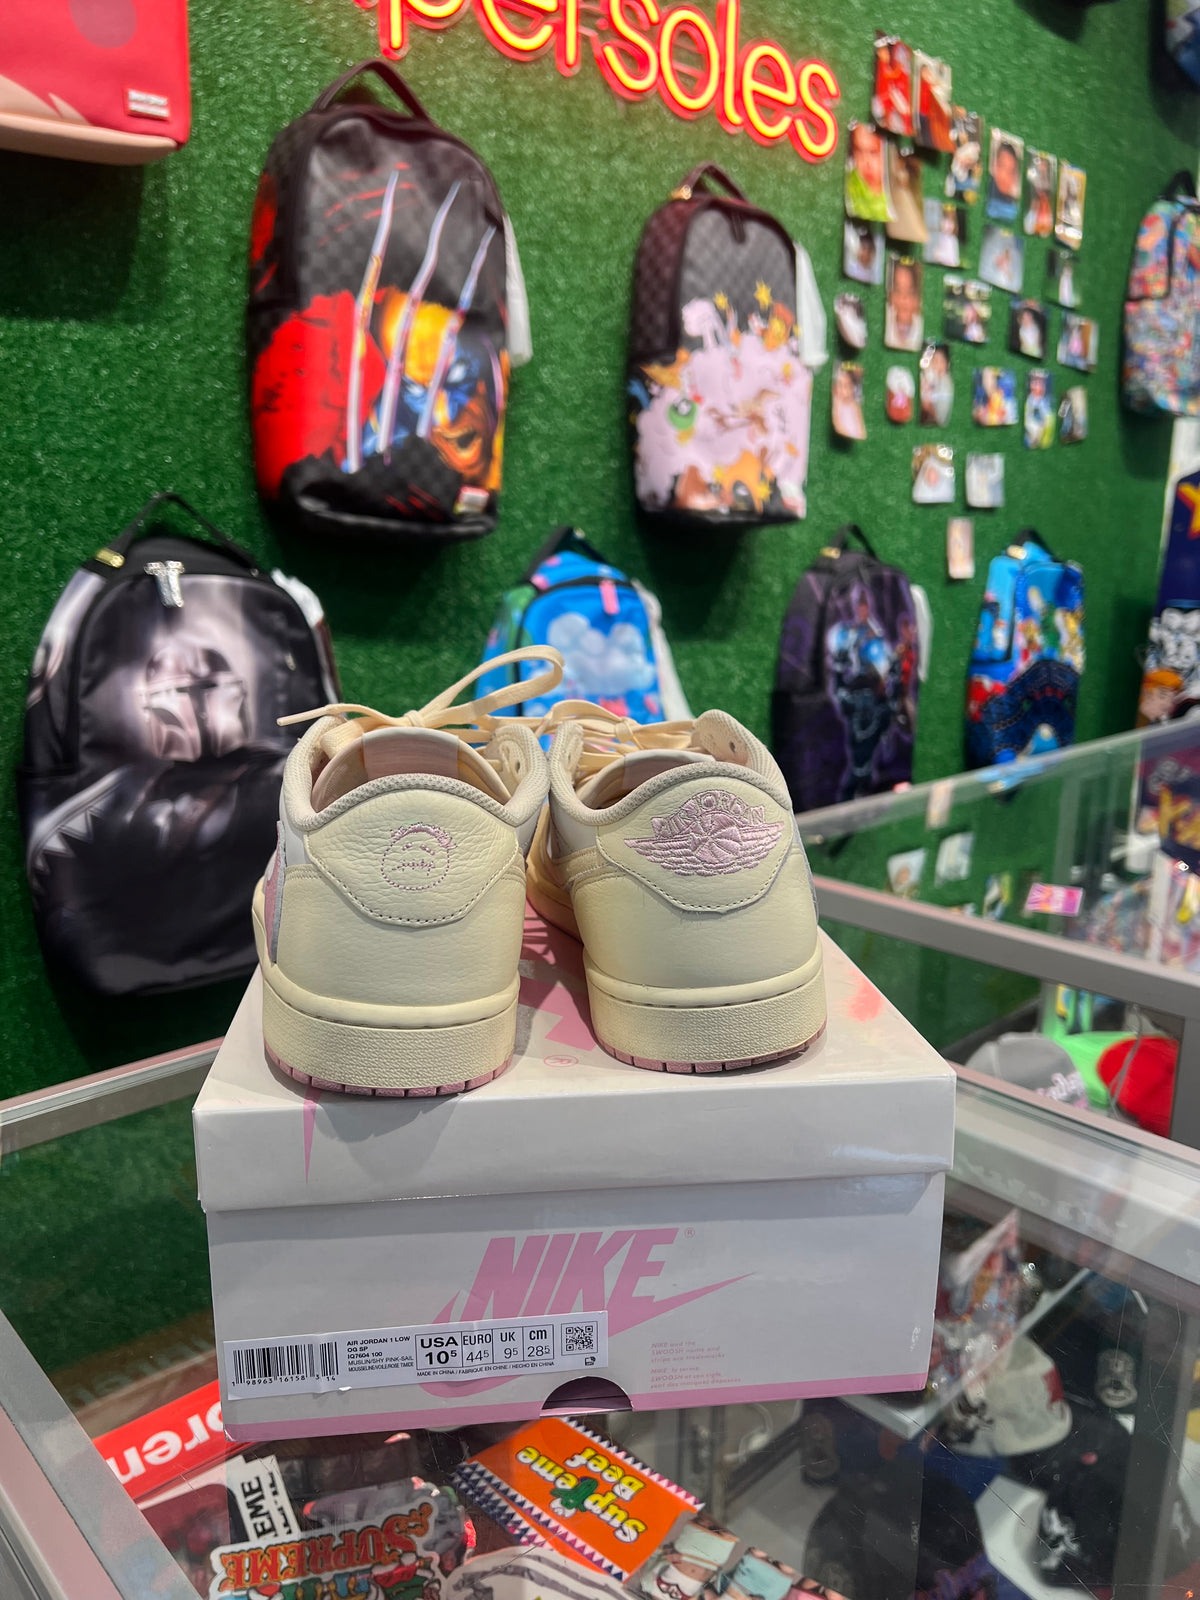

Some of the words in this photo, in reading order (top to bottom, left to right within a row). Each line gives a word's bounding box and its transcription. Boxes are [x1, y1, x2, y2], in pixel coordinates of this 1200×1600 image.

[354, 0, 840, 162] persoles
[465, 1228, 680, 1318] NIKE
[463, 1333, 492, 1346] EURO
[500, 1331, 516, 1342] UK
[529, 1328, 548, 1341] cm
[420, 1336, 459, 1349] USA
[348, 1352, 370, 1360] IQ7604
[652, 1348, 684, 1356] SWOOSH
[348, 1358, 385, 1366] MUSLIN/SHY
[279, 1375, 306, 1383] 16158
[564, 1447, 646, 1502] Beef
[516, 1446, 648, 1544] Supeme
[241, 1476, 278, 1539] EME
[218, 1504, 433, 1592] SUPREME
